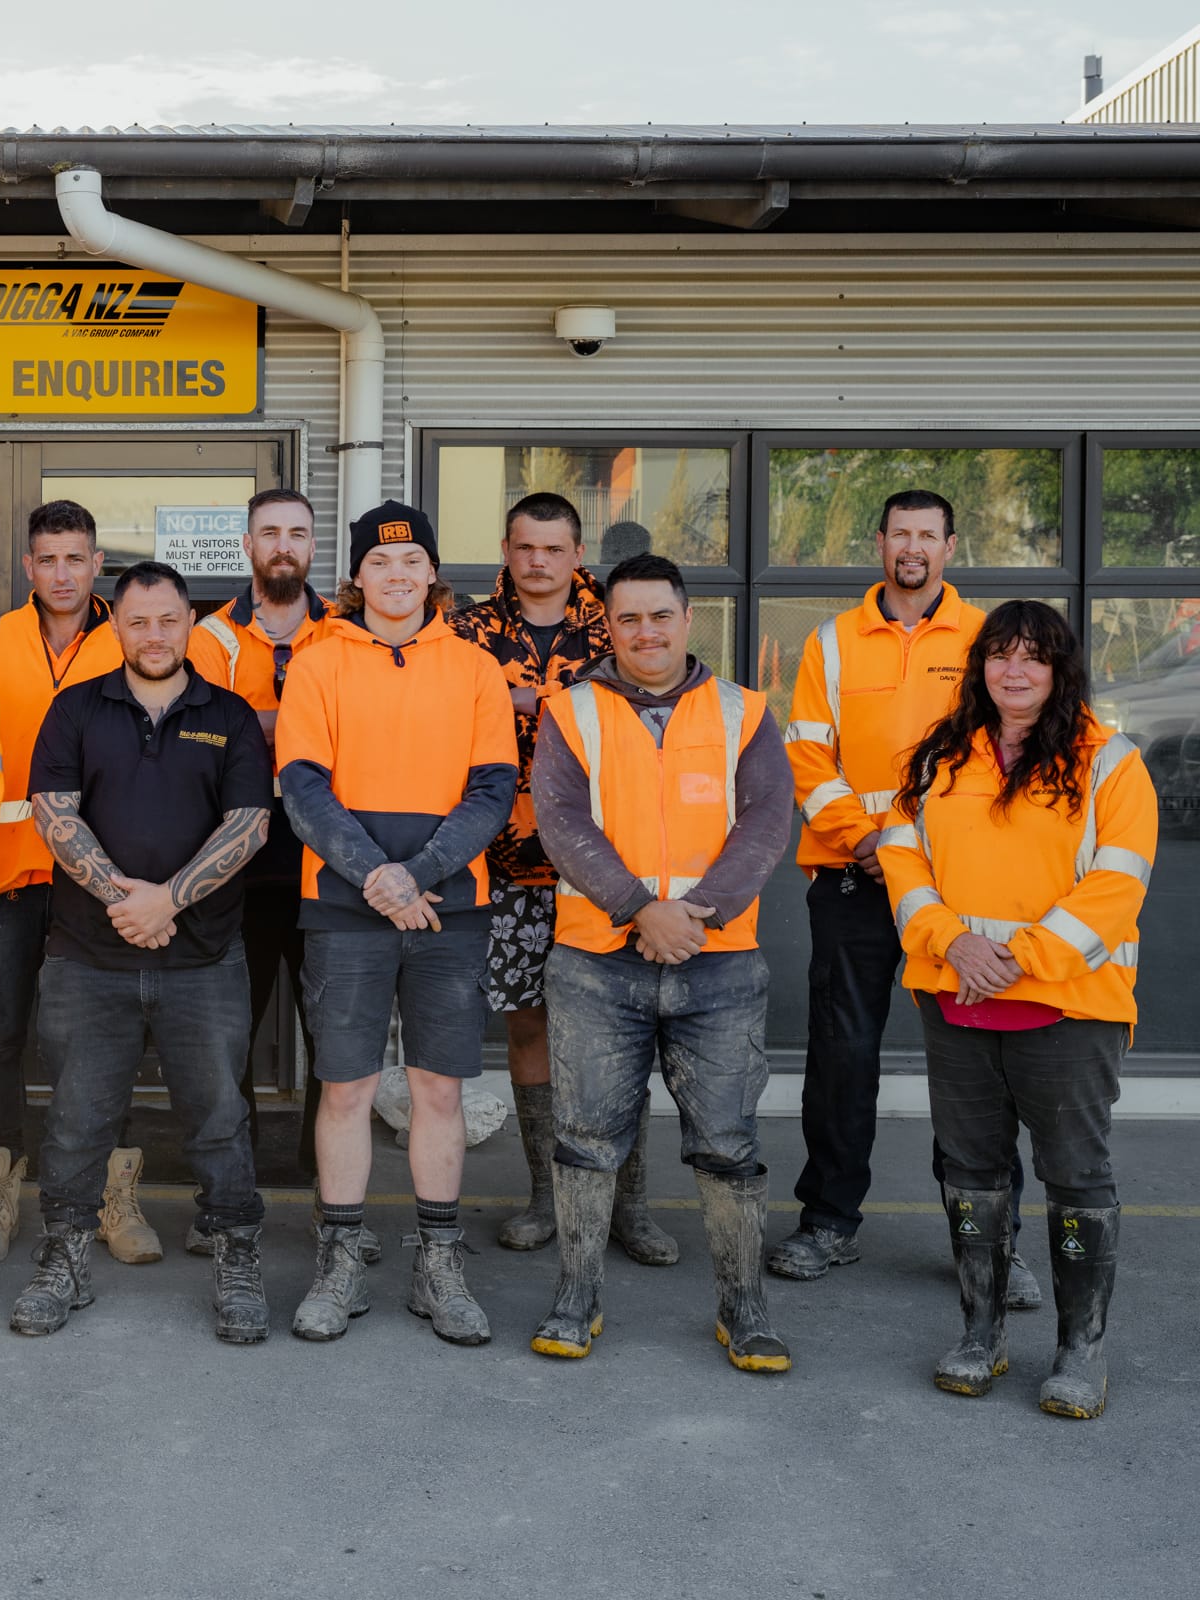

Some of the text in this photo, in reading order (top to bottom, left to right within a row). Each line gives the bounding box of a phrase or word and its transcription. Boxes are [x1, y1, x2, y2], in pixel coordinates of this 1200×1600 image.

[84, 283, 134, 320] NZ
[62, 328, 162, 338] A VAC GROUP COMPANY
[12, 359, 226, 402] ENQUIRIES
[166, 514, 242, 531] NOTICE
[383, 525, 408, 539] RB
[168, 539, 240, 548] ALL VISITORS
[165, 551, 242, 560] MUST REPORT
[182, 562, 203, 571] THE
[207, 562, 245, 571] OFFICE
